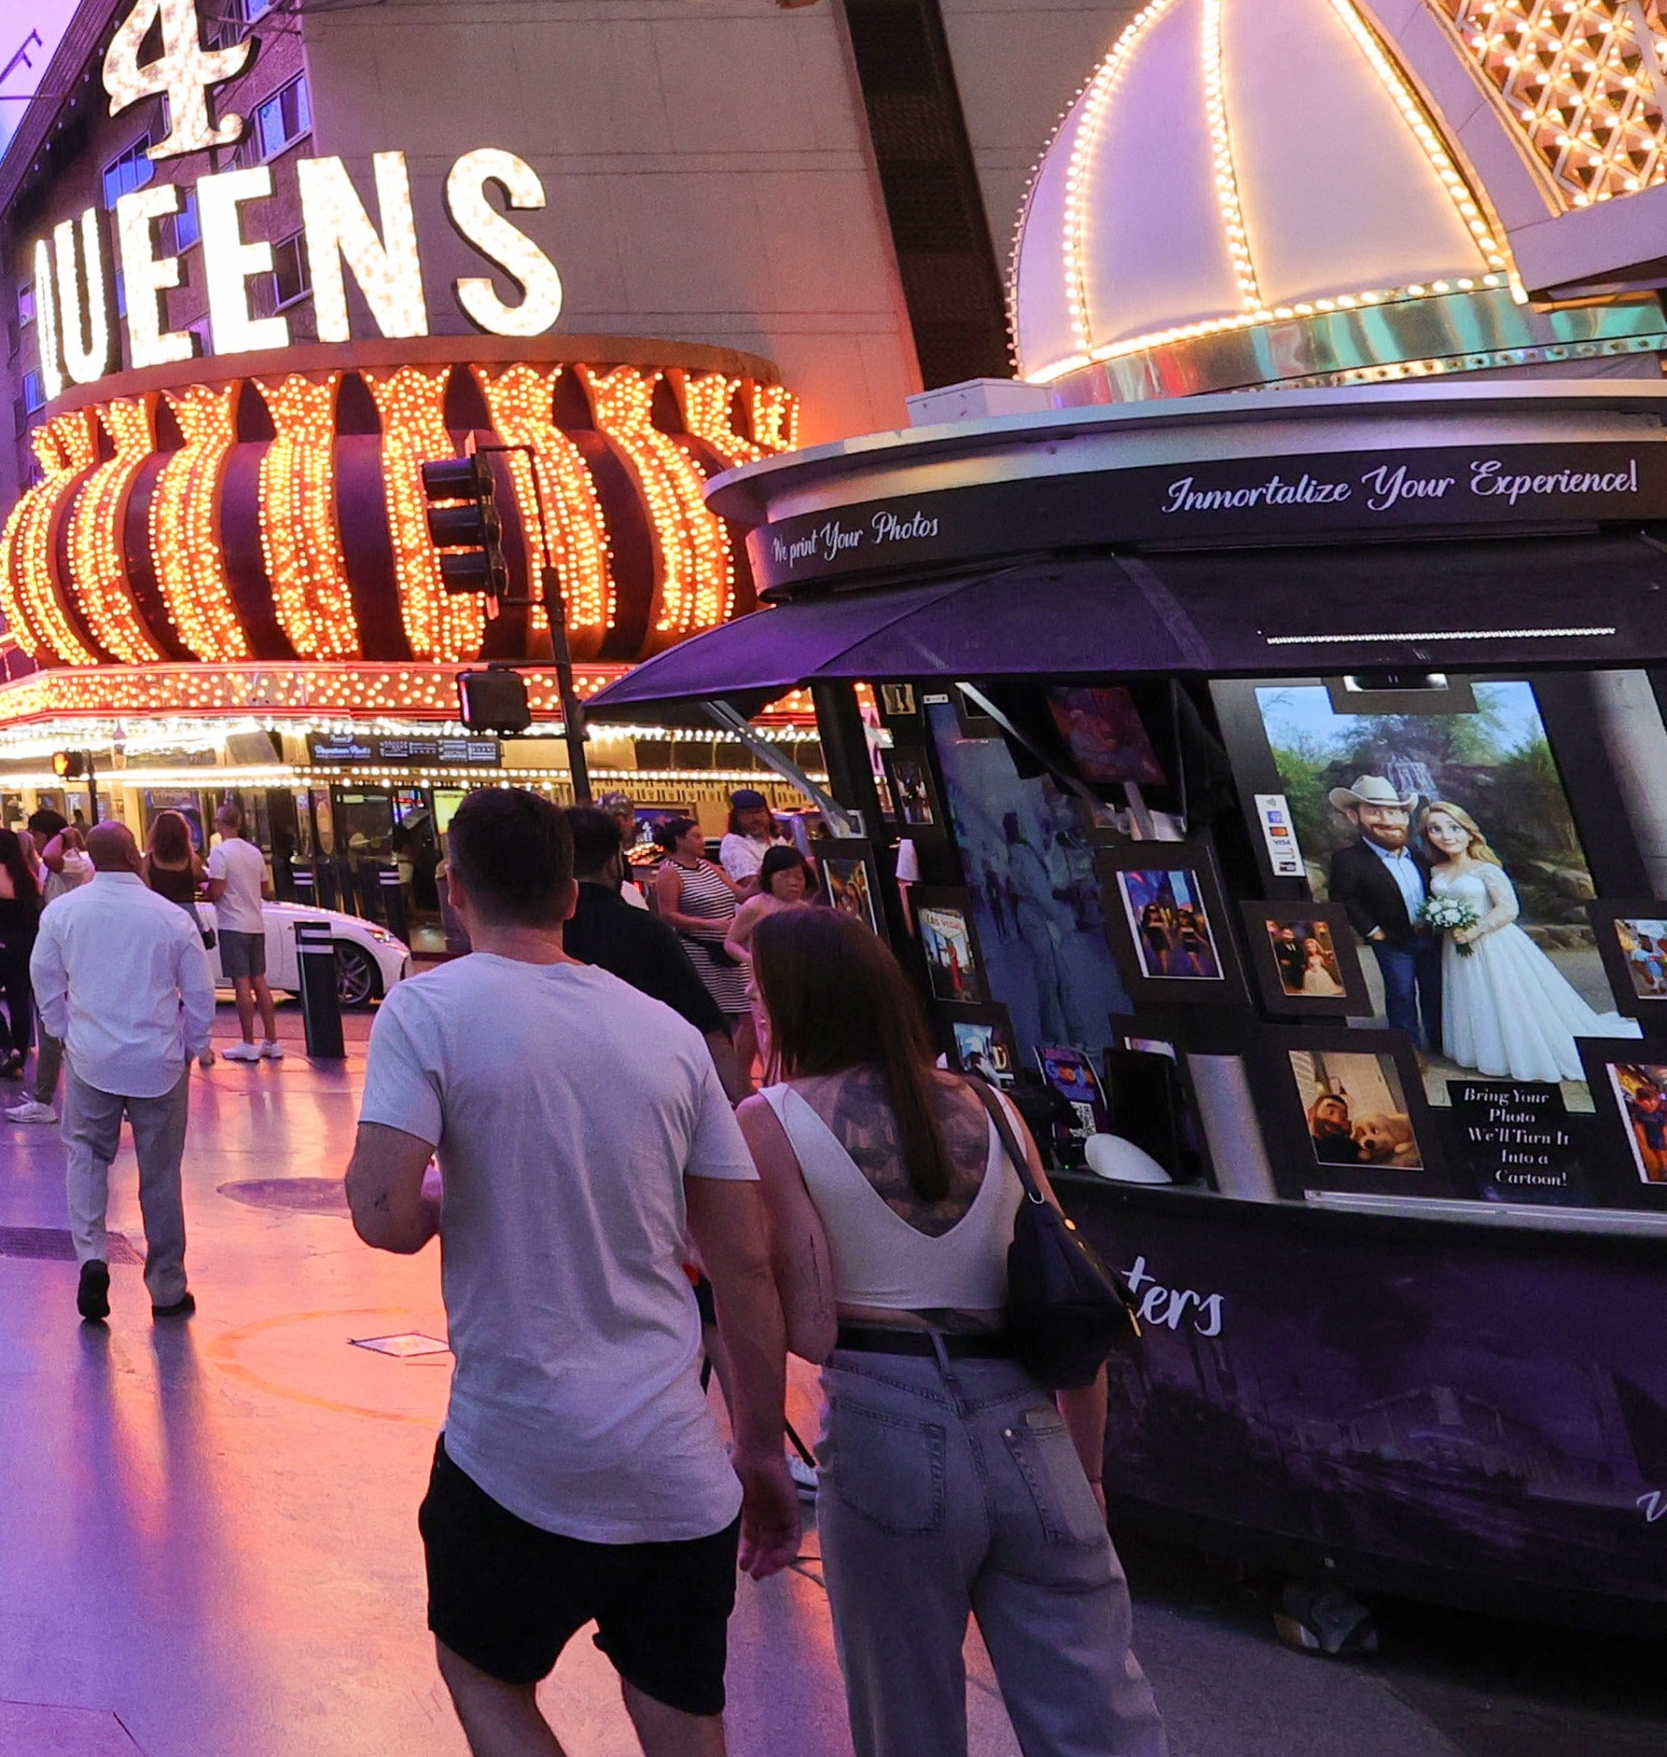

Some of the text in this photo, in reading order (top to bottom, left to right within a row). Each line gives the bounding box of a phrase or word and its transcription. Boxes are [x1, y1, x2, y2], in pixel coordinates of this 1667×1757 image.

[33, 146, 564, 403] QUEENS
[1160, 457, 1639, 518] Inmortalize Your Experience!
[771, 509, 940, 569] We print Your Photos
[1272, 838, 1292, 846] VISA
[1463, 1087, 1550, 1107] Bring Your
[1488, 1108, 1536, 1124] Photo
[1468, 1127, 1570, 1146] We'll Turn It
[1501, 1148, 1549, 1165] Into a
[1495, 1169, 1569, 1187] Cartoon!
[1121, 1254, 1225, 1337] ters
